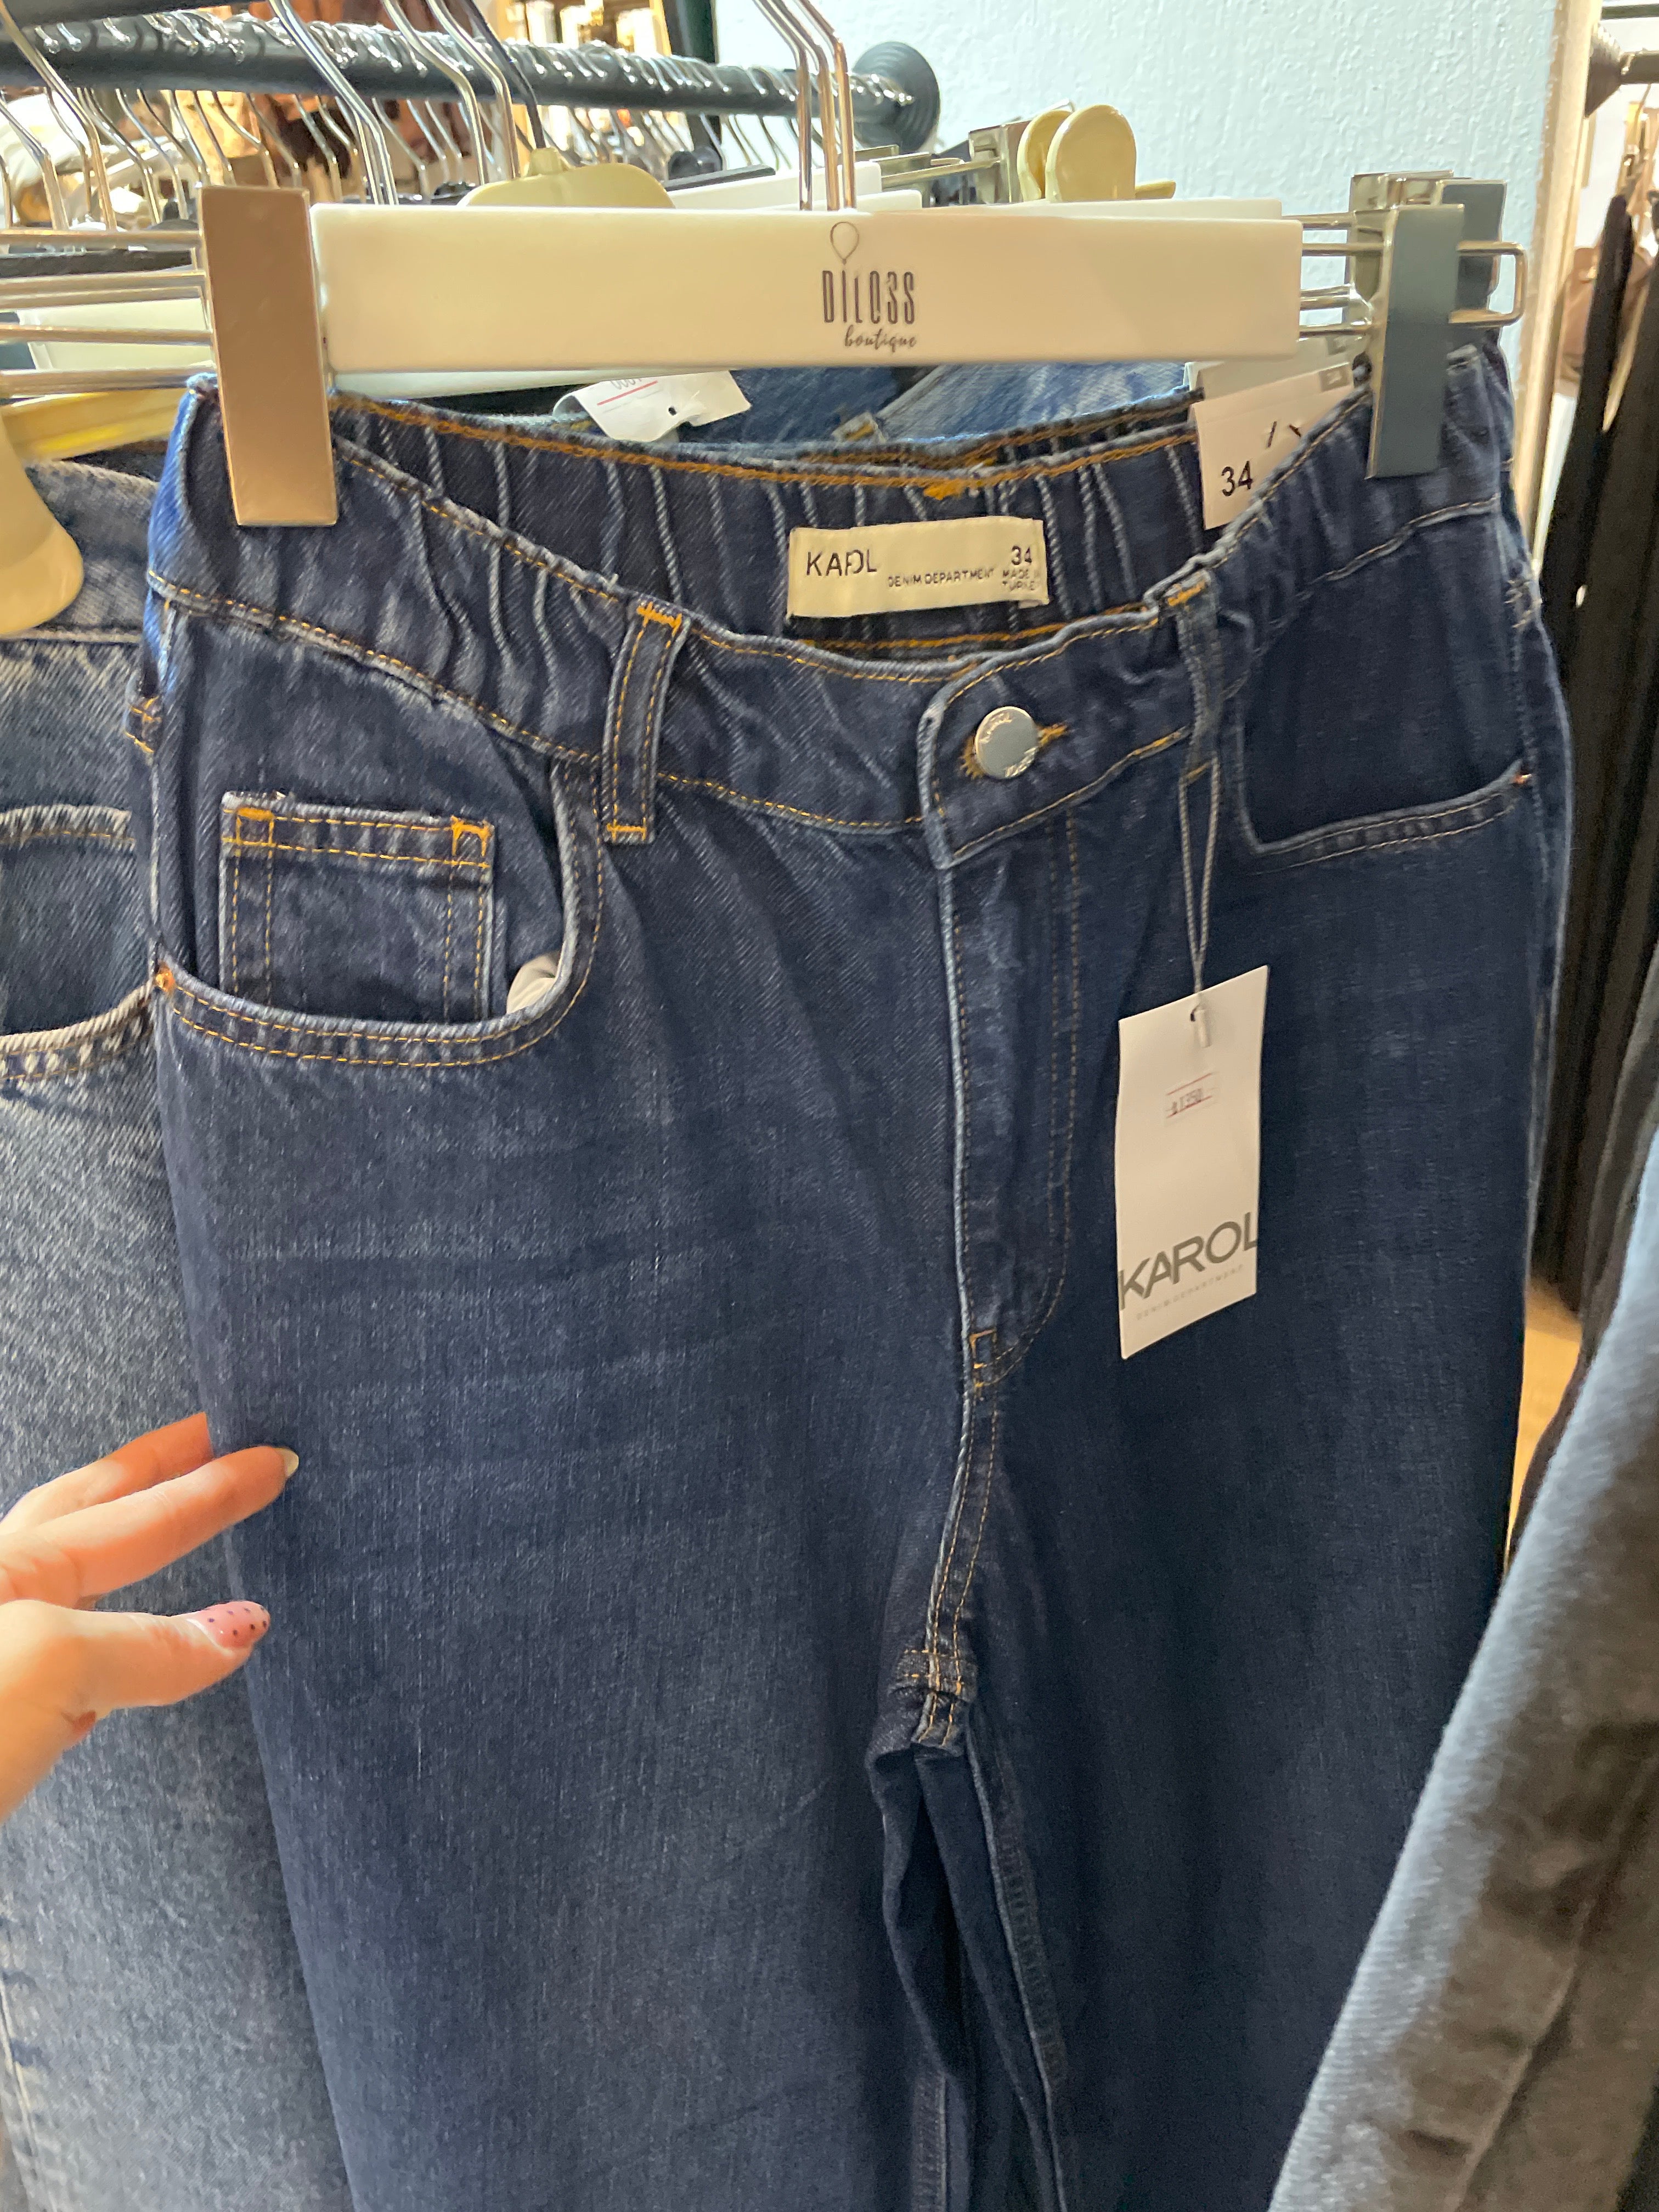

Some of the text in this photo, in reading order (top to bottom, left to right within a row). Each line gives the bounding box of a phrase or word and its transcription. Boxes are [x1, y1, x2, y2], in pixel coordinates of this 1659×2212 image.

[845, 324, 917, 353] boutique
[1221, 460, 1254, 496] 34
[1011, 545, 1032, 566] 34
[888, 574, 922, 588] DENIM
[1118, 1212, 1257, 1311] KAROL
